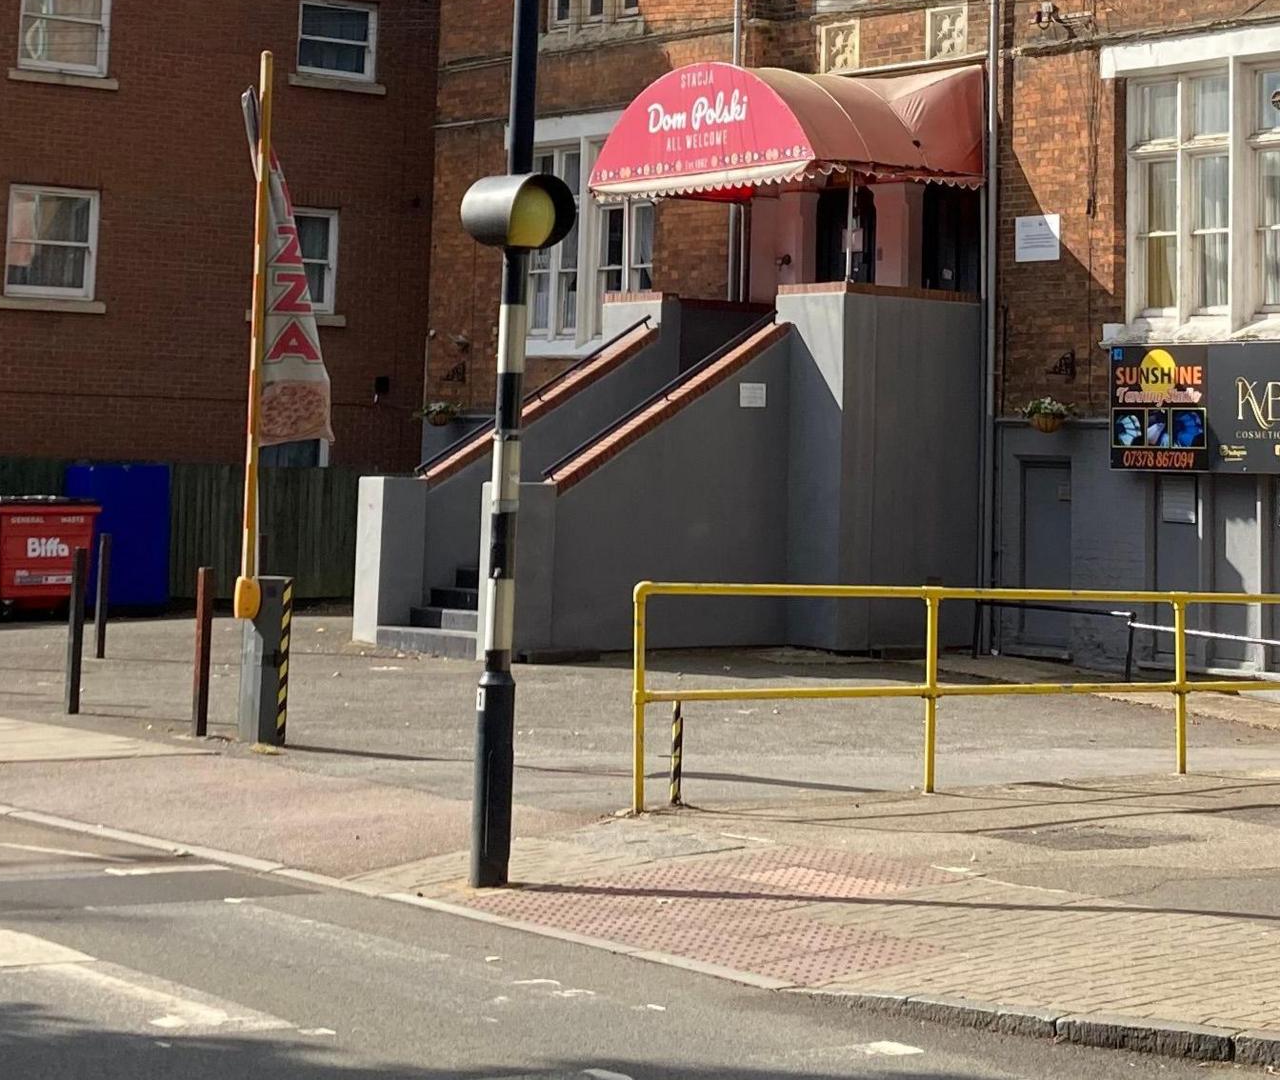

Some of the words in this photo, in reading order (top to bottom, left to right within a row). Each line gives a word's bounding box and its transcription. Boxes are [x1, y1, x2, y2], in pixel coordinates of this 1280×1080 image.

[681, 70, 714, 89] STACJA
[647, 103, 687, 133] Dom
[691, 88, 748, 130] Polski
[666, 136, 681, 152] ALL
[685, 129, 728, 150] WELCOME
[1116, 366, 1203, 385] SUNSHINE
[1122, 450, 1154, 468] 07378
[27, 537, 70, 558] Biffa
